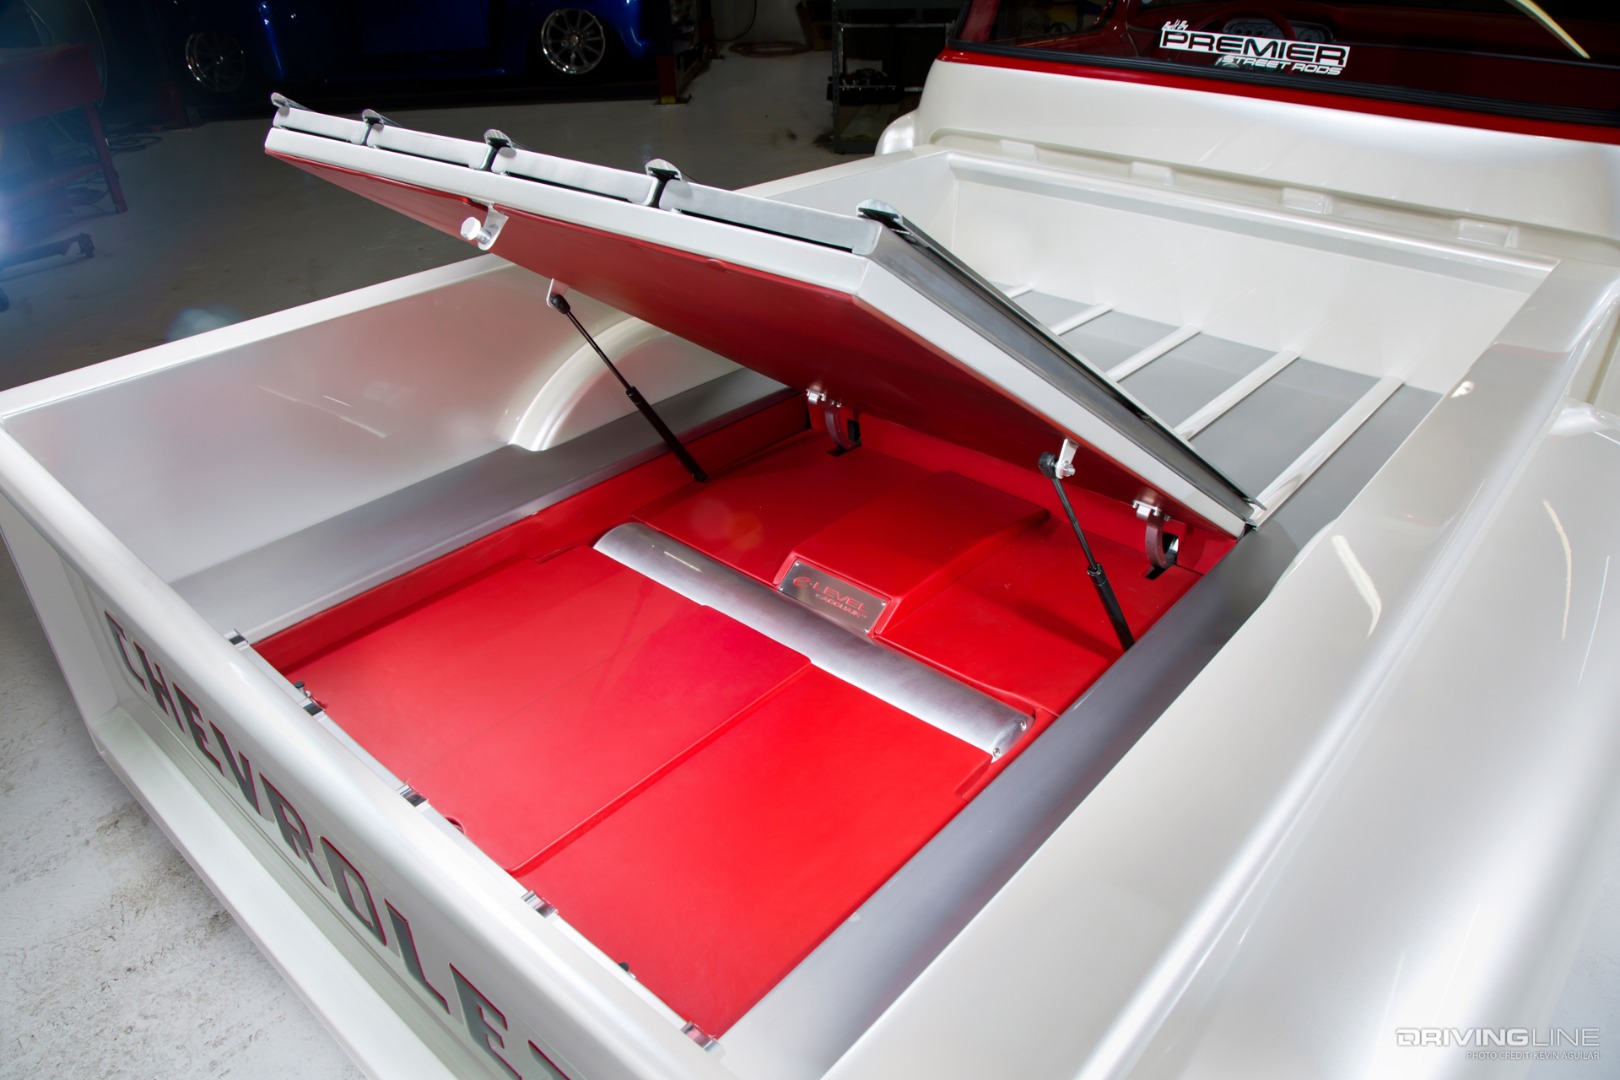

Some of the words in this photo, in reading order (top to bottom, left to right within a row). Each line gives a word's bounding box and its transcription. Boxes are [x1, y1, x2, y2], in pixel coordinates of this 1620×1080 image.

[1161, 30, 1348, 66] PREMIER
[1220, 55, 1291, 69] STREET
[1291, 63, 1343, 76] RODS
